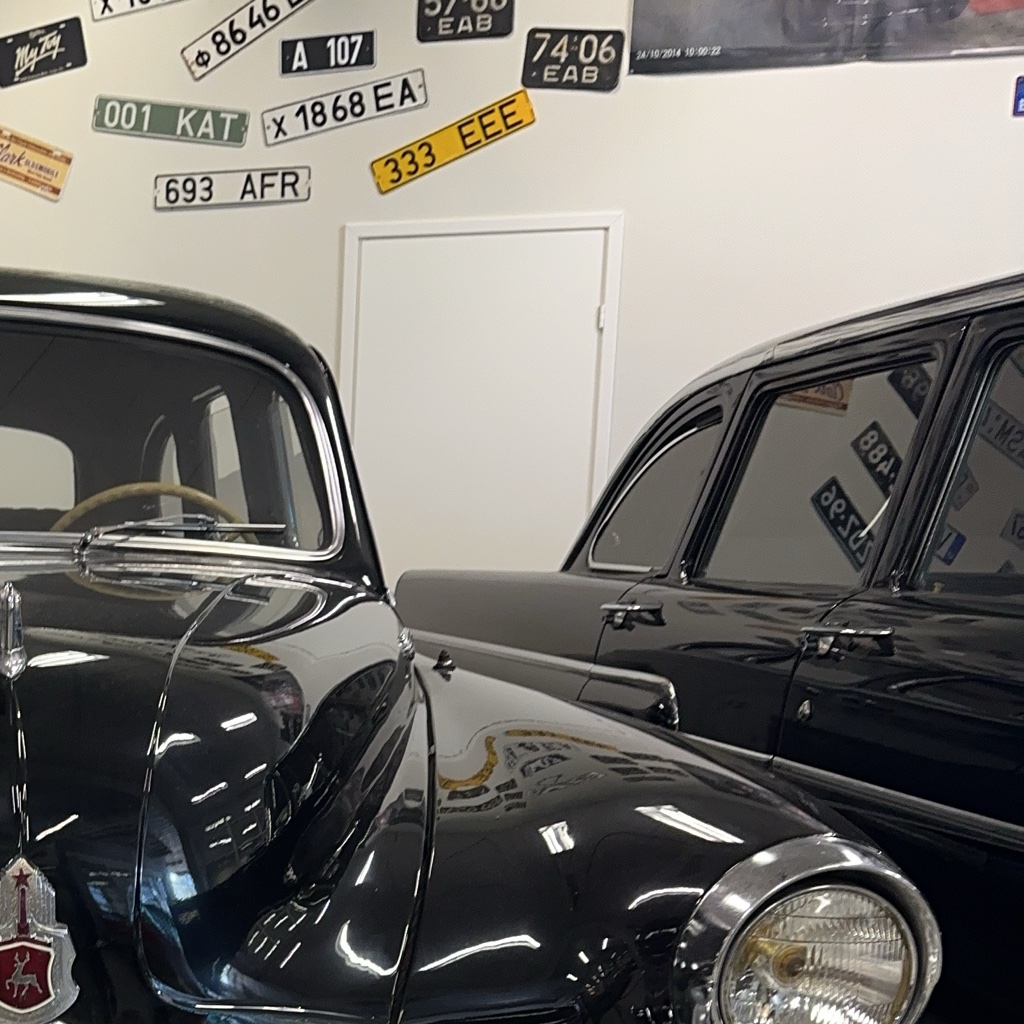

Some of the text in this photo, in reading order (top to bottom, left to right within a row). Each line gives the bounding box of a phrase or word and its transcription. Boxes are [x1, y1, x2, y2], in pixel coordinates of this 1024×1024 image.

[291, 35, 363, 71] A 107
[543, 64, 598, 83] EAB
[104, 101, 238, 141] 001 KAT
[295, 91, 365, 132] 1868
[374, 77, 418, 112] EA
[384, 98, 524, 184] 333 EEE
[165, 171, 300, 204] 693 AFR
